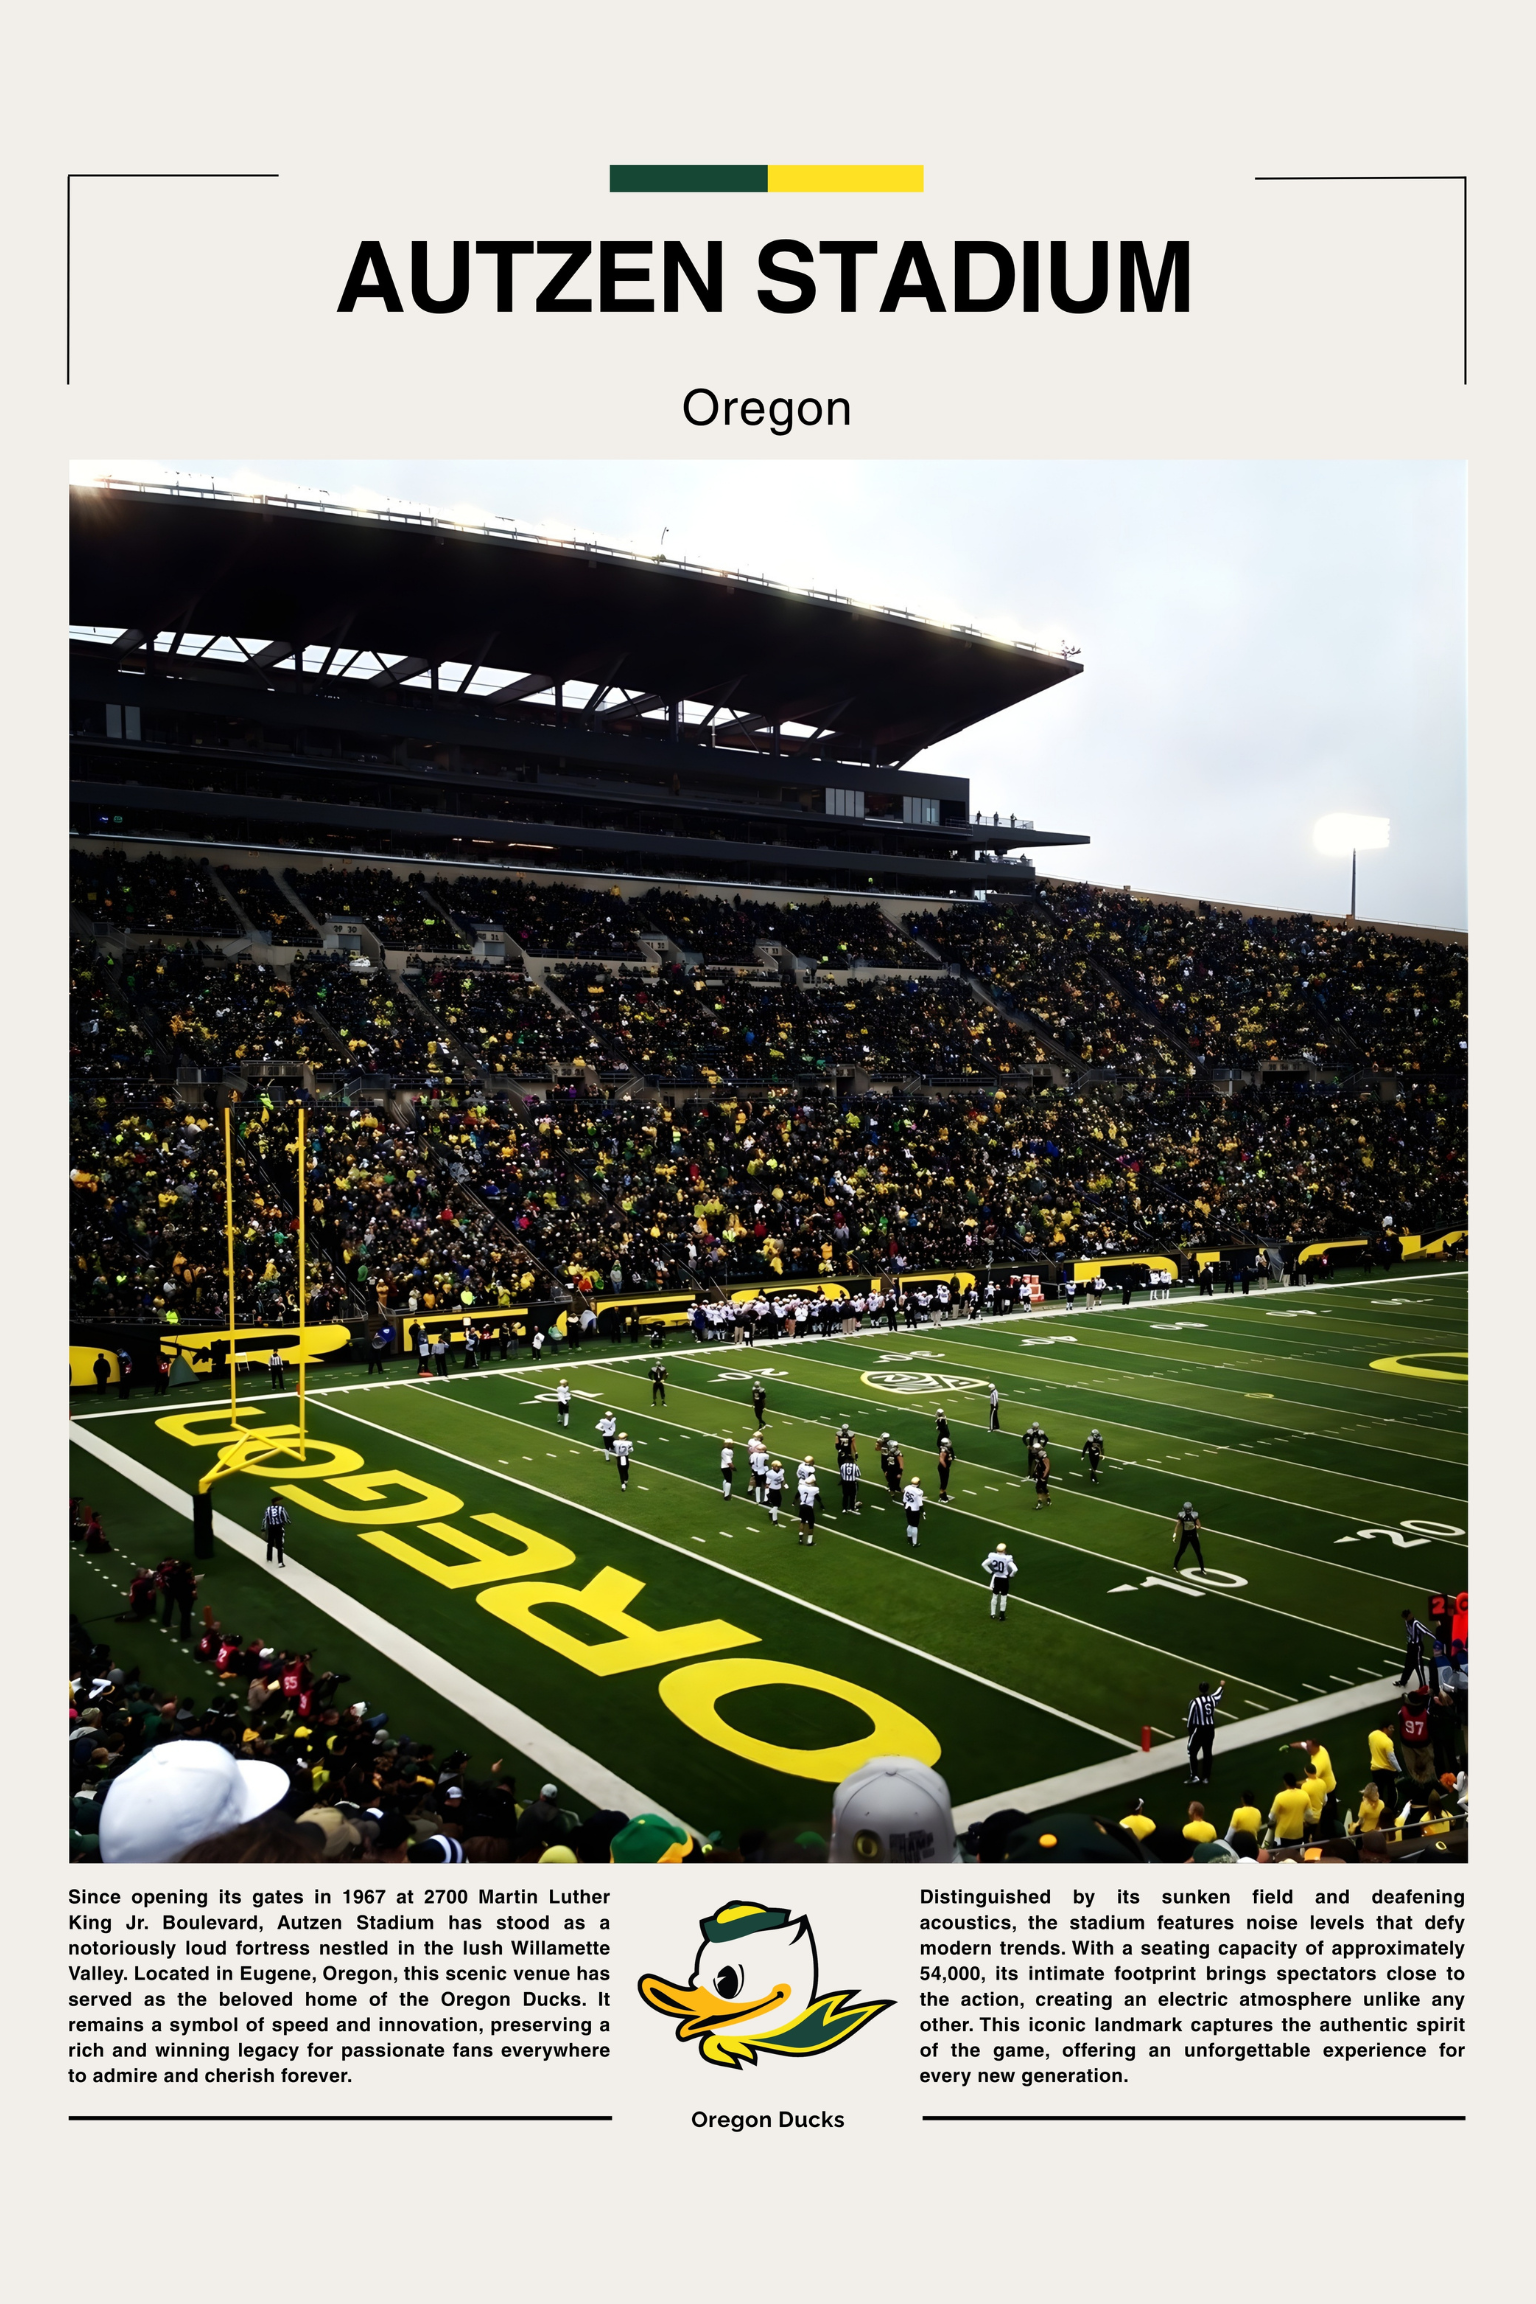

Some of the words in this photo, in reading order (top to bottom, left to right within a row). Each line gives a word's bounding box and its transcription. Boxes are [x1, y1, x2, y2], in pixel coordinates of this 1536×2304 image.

[1356, 1519, 1466, 1549] 20
[154, 1406, 941, 1783] OREGON
[1139, 1567, 1249, 1597] 10
[1405, 1720, 1424, 1736] 97
